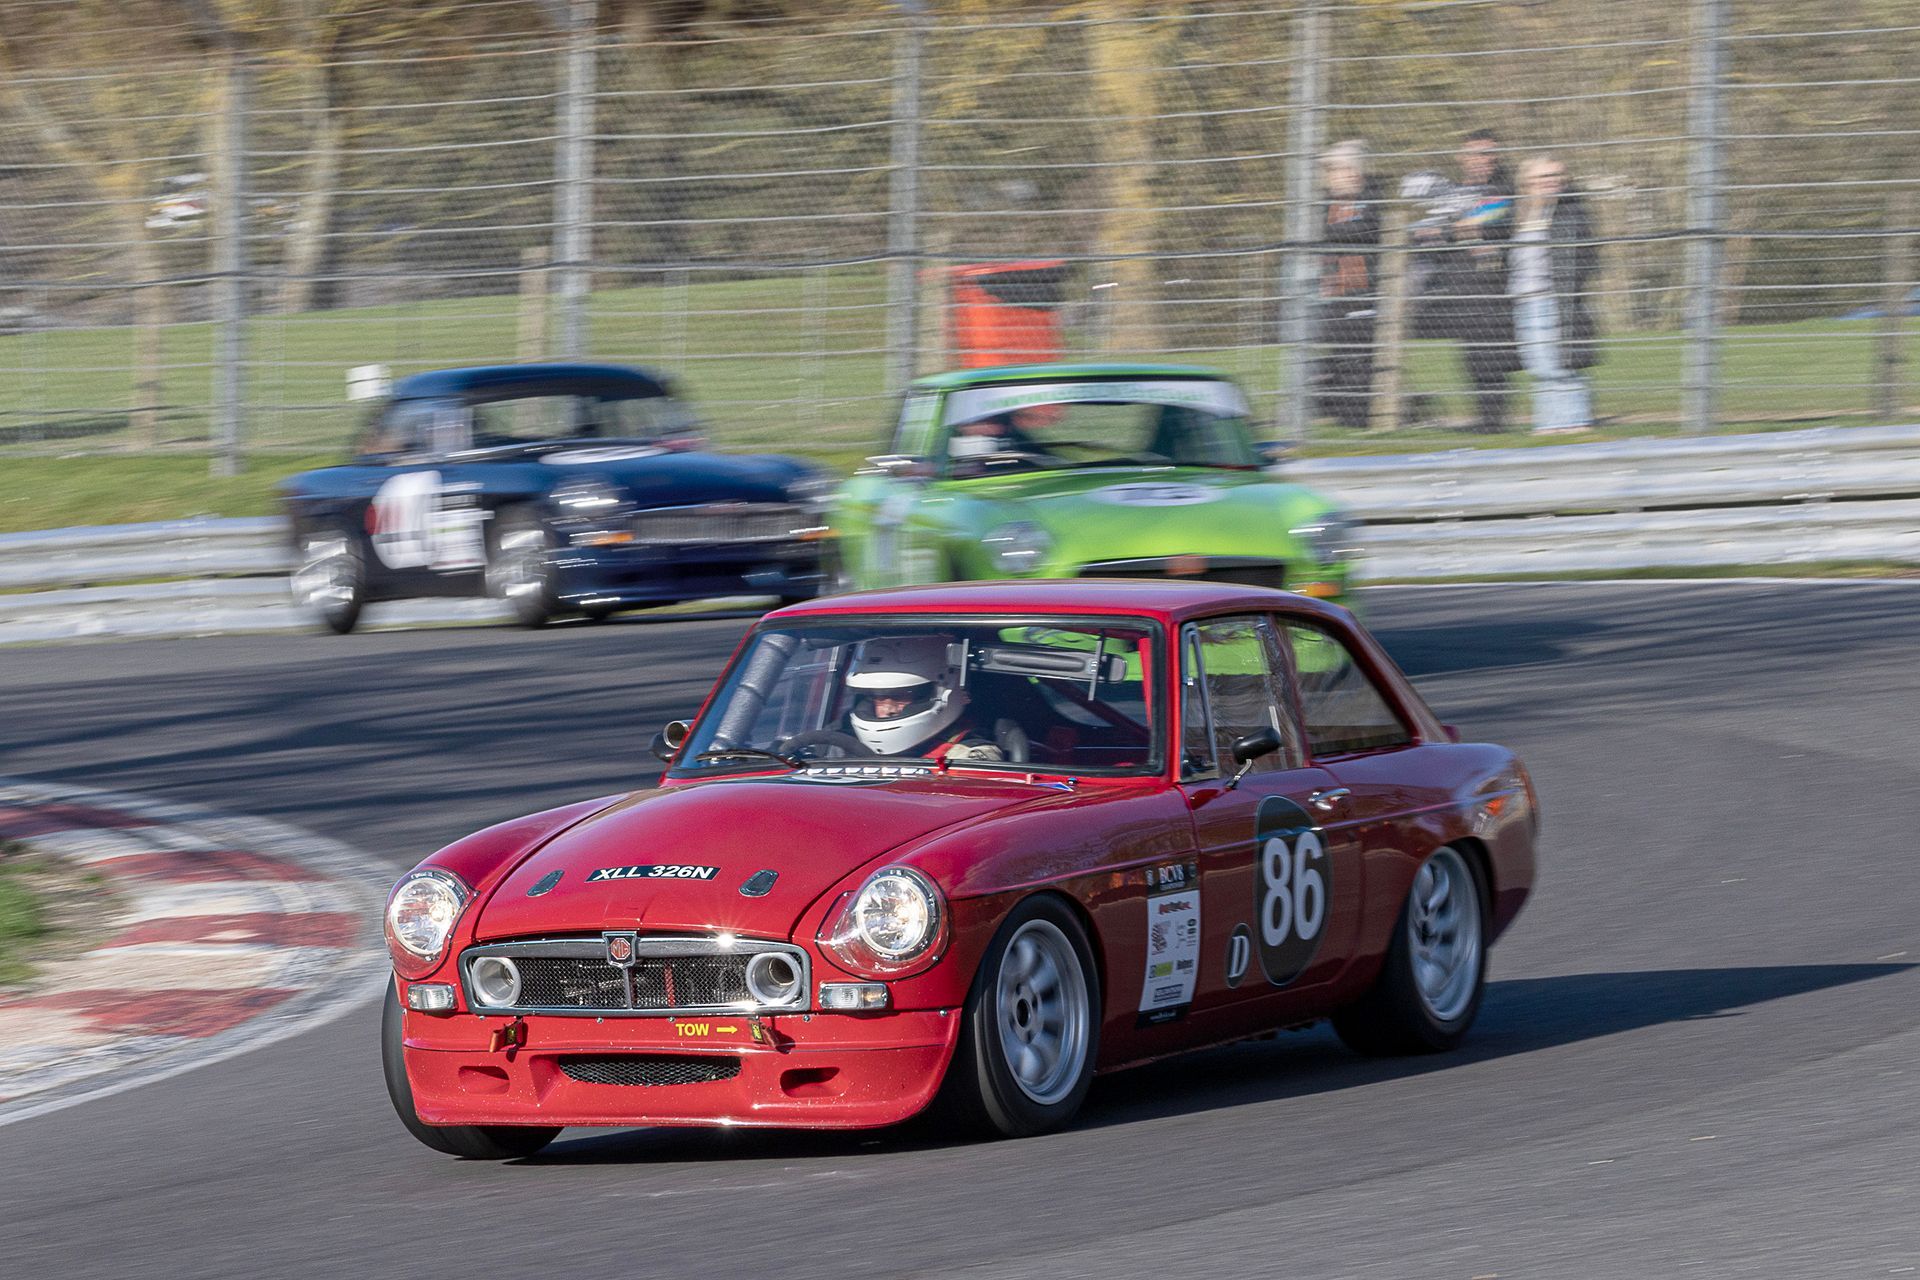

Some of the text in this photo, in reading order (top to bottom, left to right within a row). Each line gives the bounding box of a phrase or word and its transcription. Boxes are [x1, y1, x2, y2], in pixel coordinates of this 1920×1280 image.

[592, 865, 714, 881] XLL 326N
[1261, 831, 1325, 947] 86
[612, 939, 631, 958] MG
[1228, 935, 1250, 978] D
[675, 1023, 709, 1036] TOW
